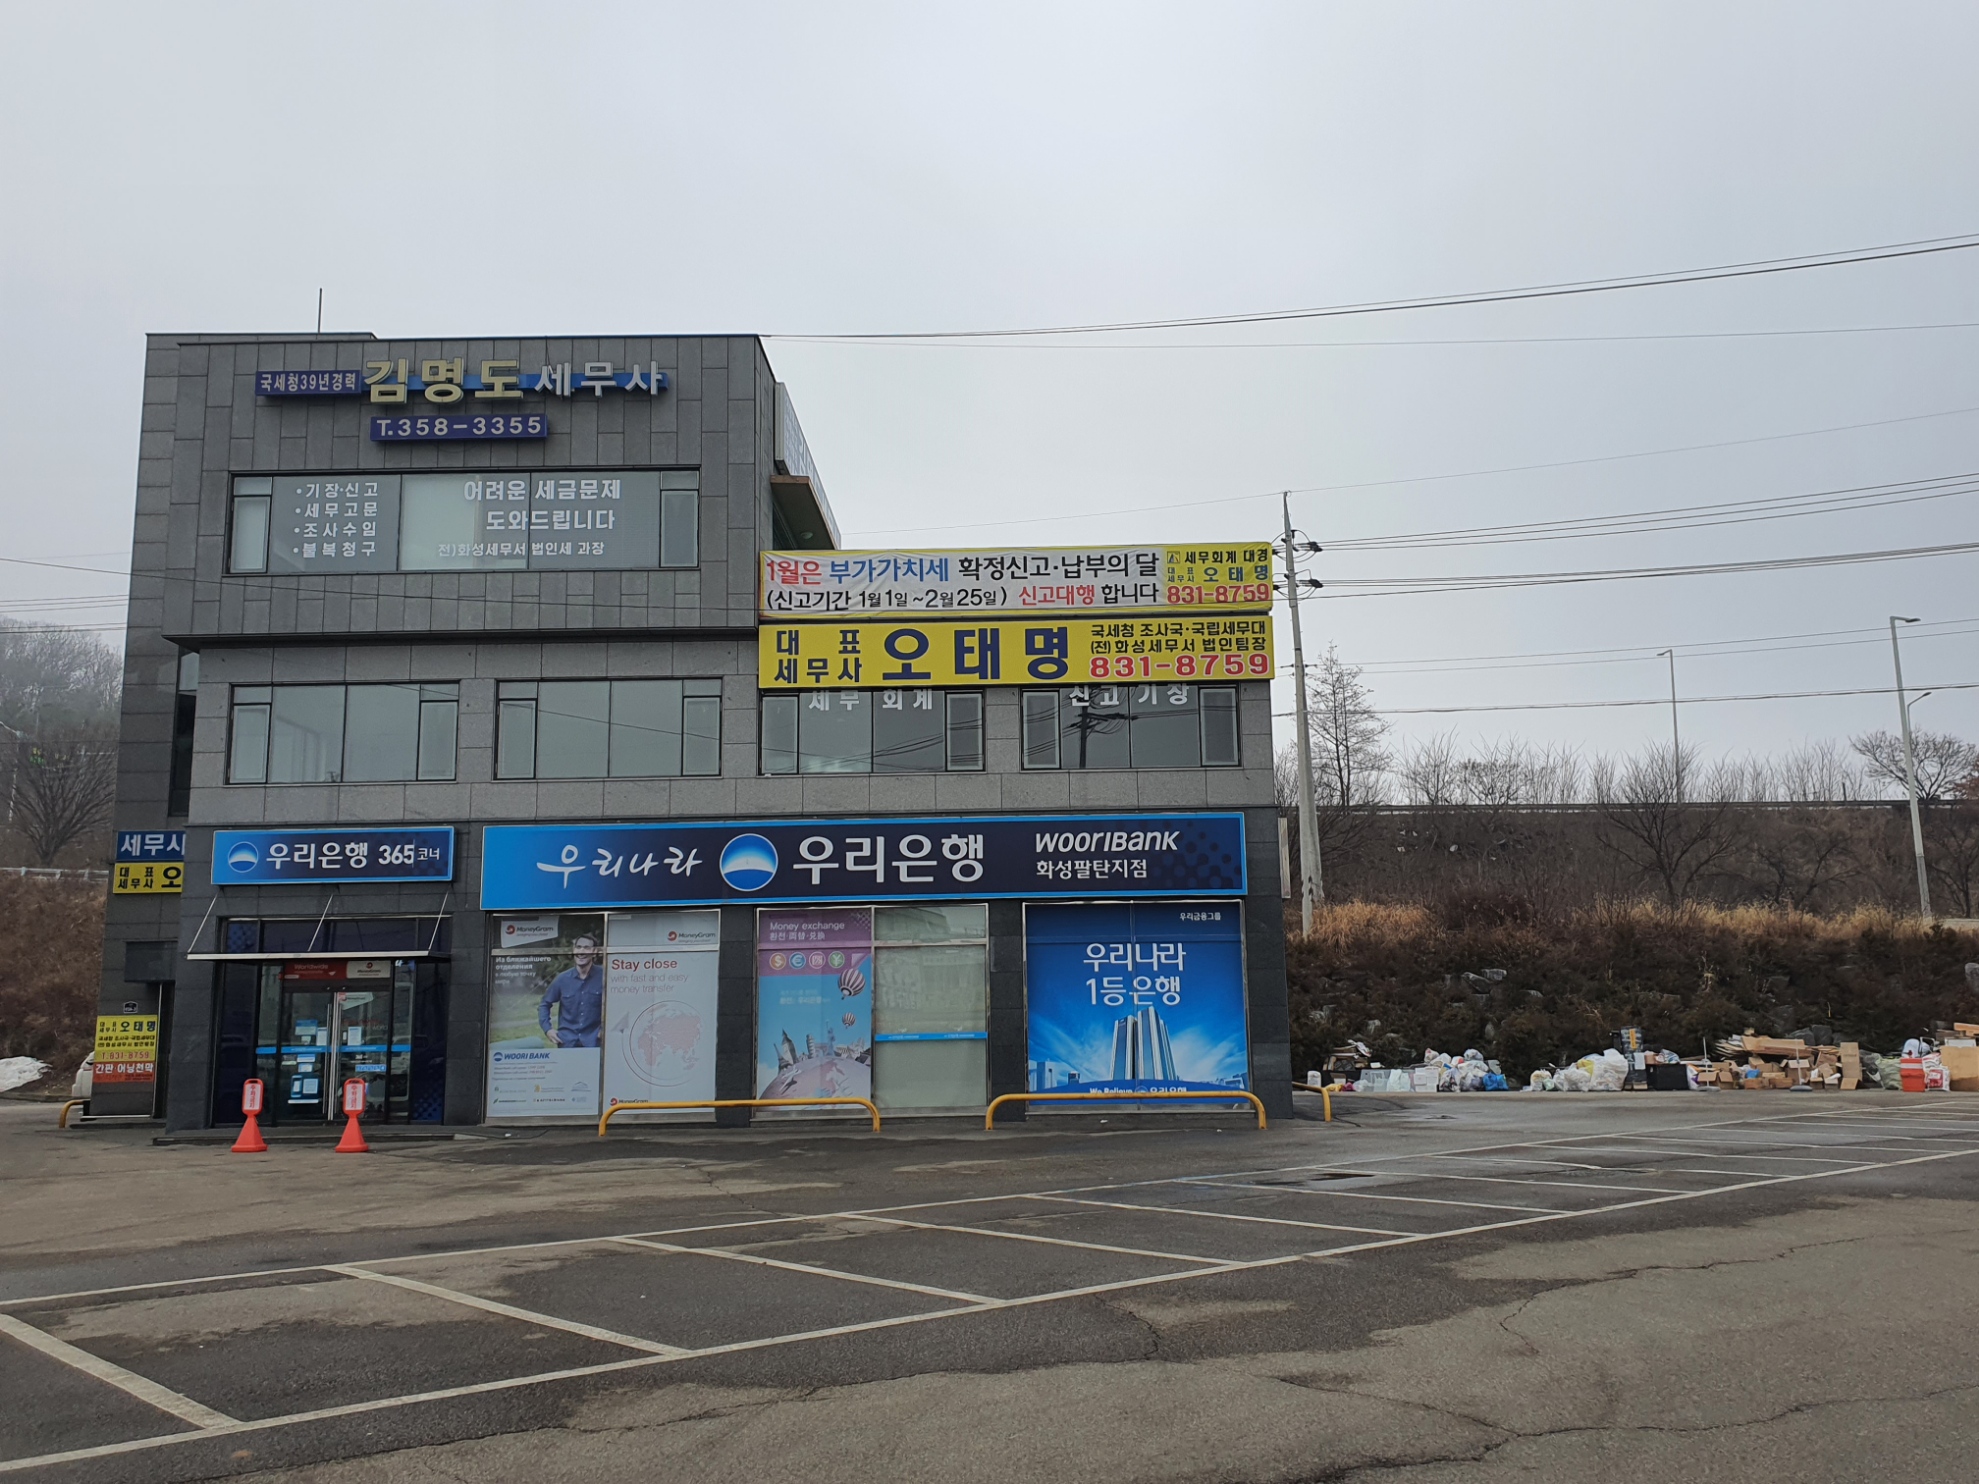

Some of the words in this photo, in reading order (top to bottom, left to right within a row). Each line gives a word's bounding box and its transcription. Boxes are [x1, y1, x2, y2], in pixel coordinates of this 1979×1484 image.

[260, 372, 356, 392] 국세청39년경력
[364, 357, 523, 403] 김명도
[534, 361, 662, 397] 세무사
[377, 416, 541, 437] T.358-3355
[464, 480, 526, 501] 어려운
[534, 479, 622, 500] 세금문제
[304, 502, 378, 518] 세무고문
[486, 509, 616, 531] 도와드립니다
[303, 521, 376, 538] 조사수임
[302, 541, 376, 559] 불복청구
[531, 541, 572, 556] 법인세
[577, 541, 605, 556] 과장
[1184, 550, 1237, 564] 세무회계
[1243, 548, 1268, 563] 대경
[766, 560, 822, 585] 1월은
[829, 557, 949, 585] 부가가치세
[1136, 552, 1160, 577] 달
[767, 589, 850, 611] (신고기간
[1018, 584, 1096, 606] 신고대행
[1101, 582, 1160, 605] 합니다
[1167, 583, 1270, 605] 831-8759
[1090, 623, 1134, 639] 국세청
[882, 626, 1069, 681] 오태명
[1202, 637, 1266, 652] 법인팀장
[773, 657, 862, 684] 세무사
[1089, 652, 1270, 678] 831-8759
[266, 841, 369, 870] 우리은행
[536, 844, 703, 890] 우리나라
[793, 833, 984, 886] 우리은행
[1036, 858, 1148, 880] 화성팔탄지점
[770, 922, 799, 931] Money
[801, 921, 845, 931] exchange
[611, 959, 640, 972] Stay
[643, 958, 678, 970] close
[1083, 942, 1187, 972] 우리나라
[630, 974, 646, 982] fast
[648, 973, 666, 982] and
[667, 974, 689, 983] easy
[610, 986, 640, 994] money
[1086, 975, 1181, 1006] 1등은행
